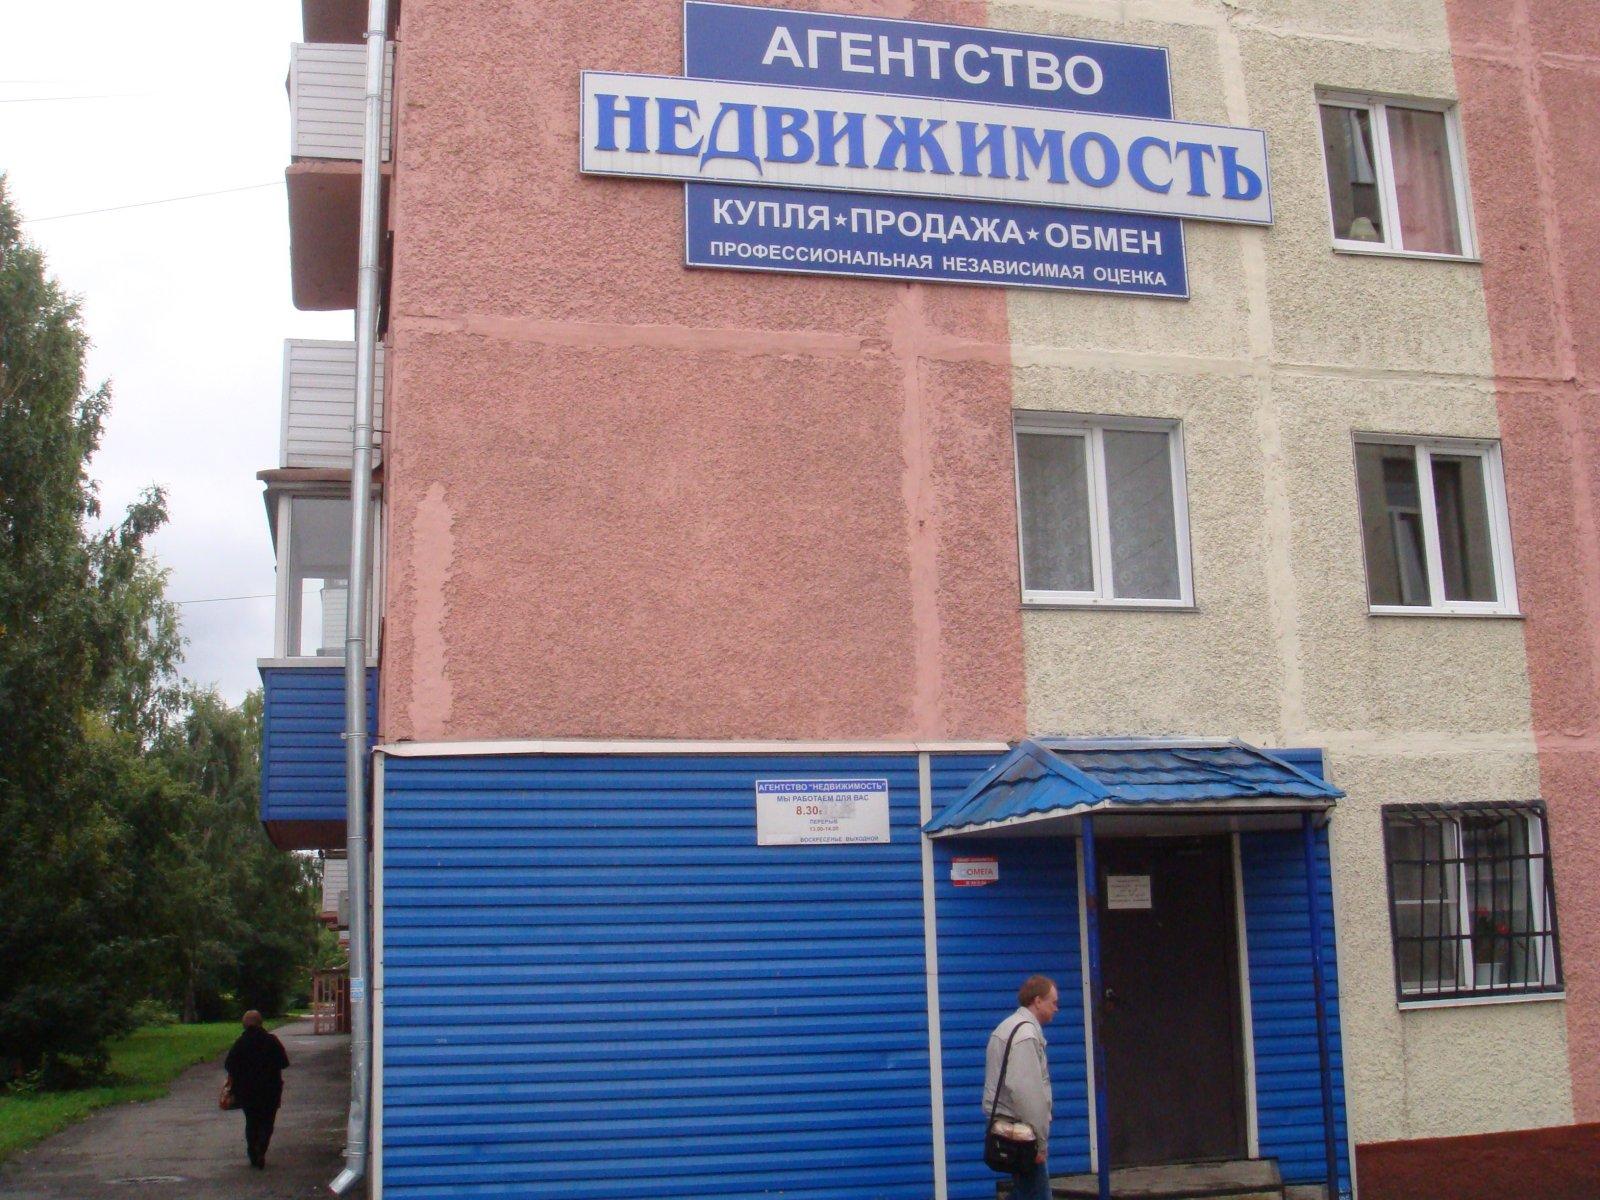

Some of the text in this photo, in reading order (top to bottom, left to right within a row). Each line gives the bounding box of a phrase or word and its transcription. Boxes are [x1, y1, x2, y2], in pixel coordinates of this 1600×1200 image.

[761, 25, 1104, 97] АГЕНТСТВО
[593, 92, 1263, 202] НЕДВИЖИМОСТЬ
[712, 197, 1163, 256] КУПЛЯ ПРОДАЖА ОБМЕН
[709, 239, 1167, 287] ПРОФЕССИОНАЛЬНАЯ НЕЗАВИСИМАЯ ОЦЕНКА
[758, 781, 886, 791] АГЕНТСТВО "НЕДВИЖИМОСТЬ"
[835, 794, 852, 802] ДЛЯ
